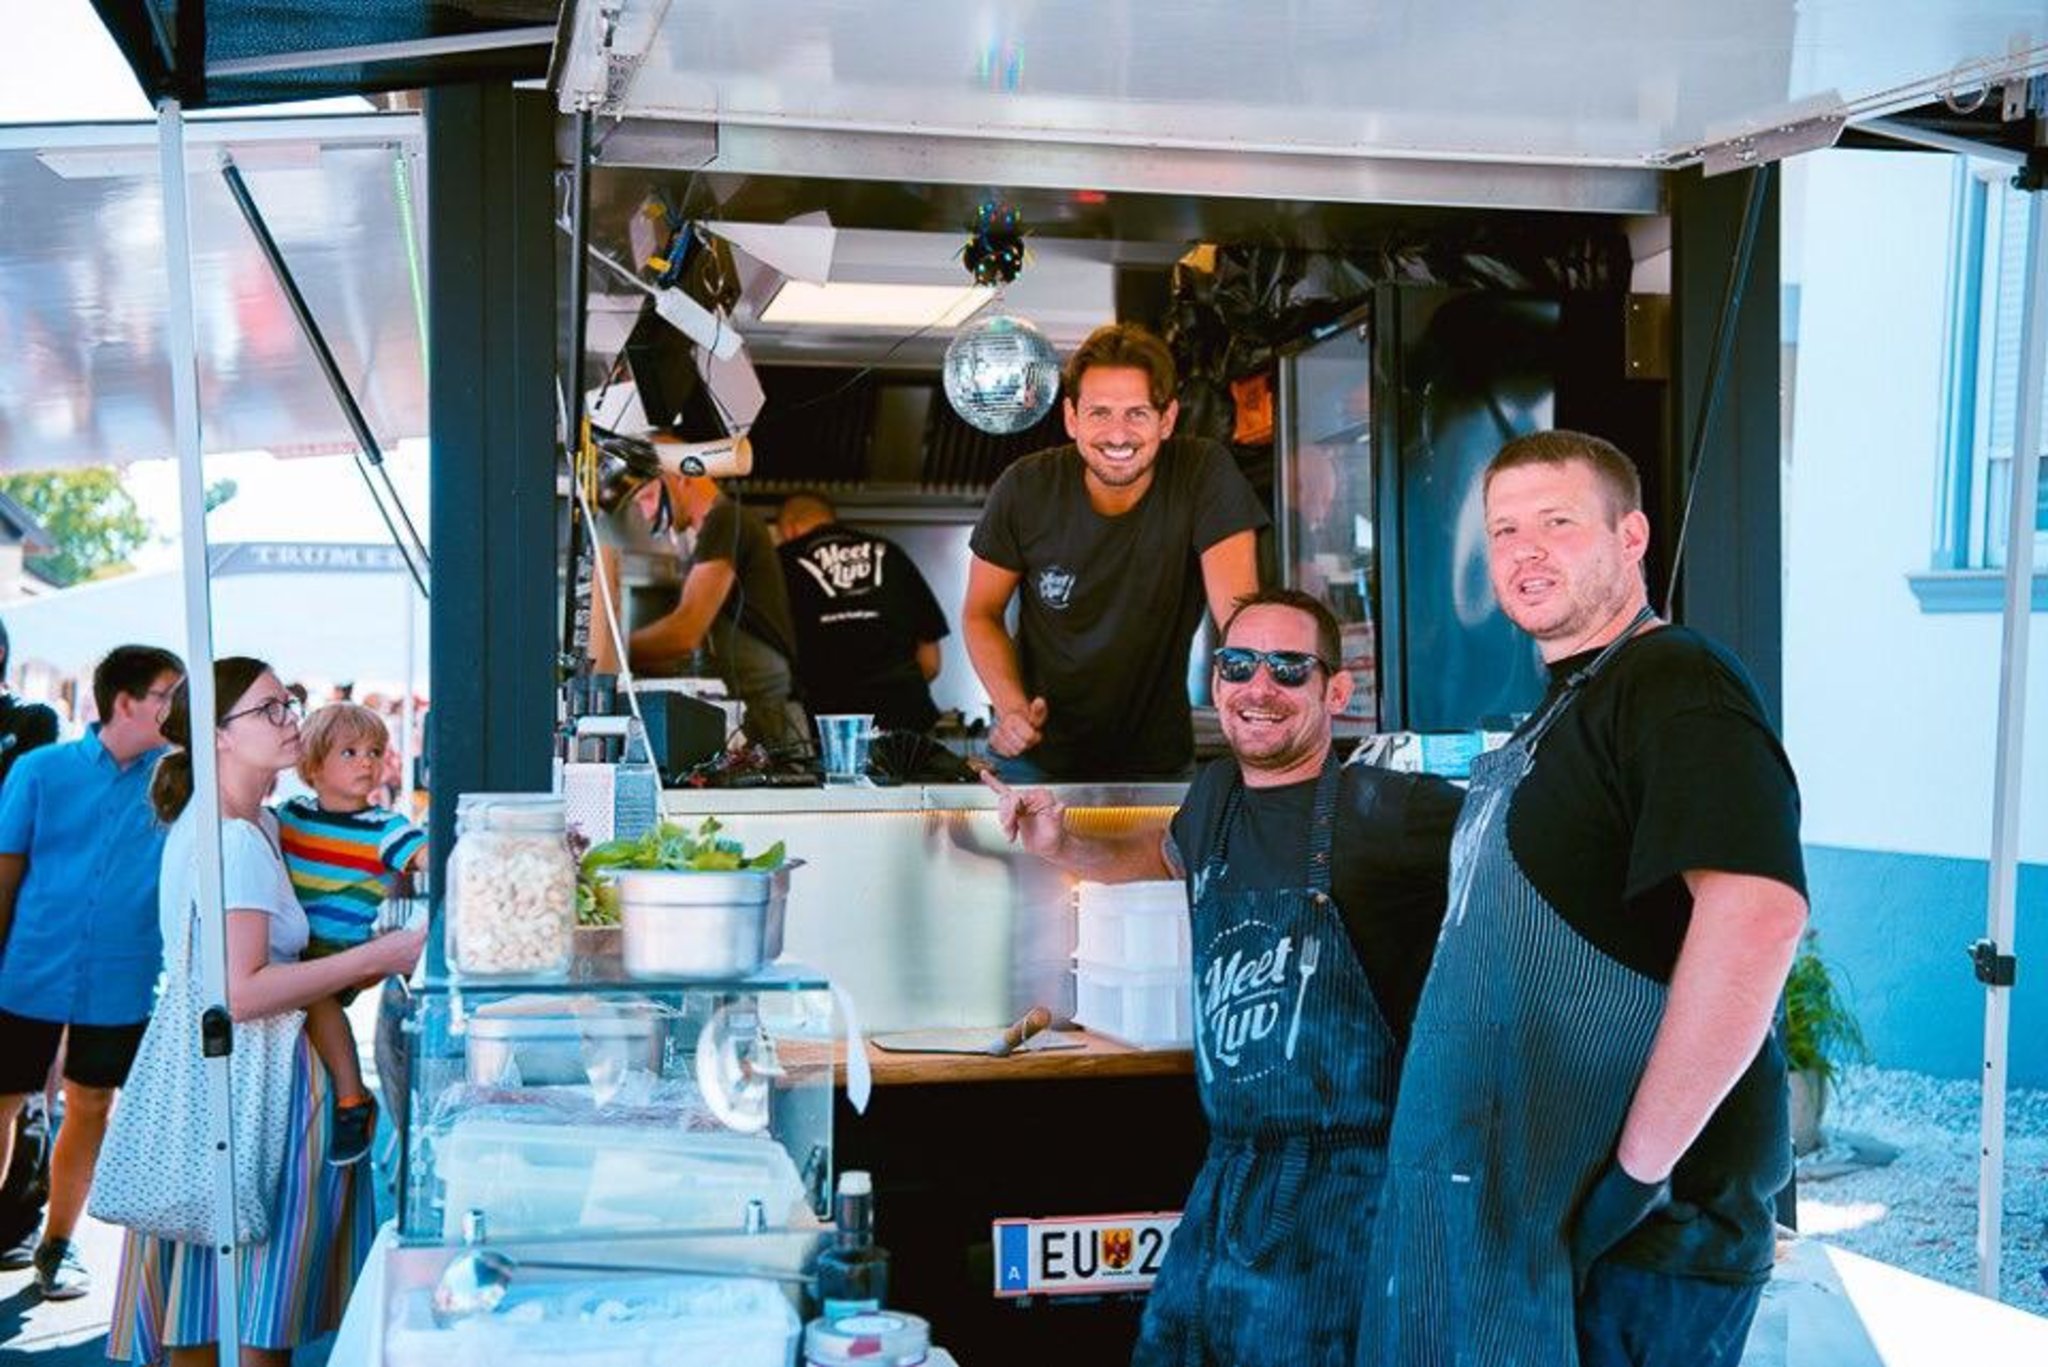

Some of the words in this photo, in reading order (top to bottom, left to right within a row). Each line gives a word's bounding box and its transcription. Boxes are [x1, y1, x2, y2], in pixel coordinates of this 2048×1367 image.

[814, 542, 870, 571] Meet
[1205, 936, 1293, 1017] Meet
[1211, 1001, 1279, 1067] Luv
[1008, 1266, 1020, 1280] A
[1042, 1230, 1098, 1279] EU
[1138, 1227, 1163, 1275] 2
